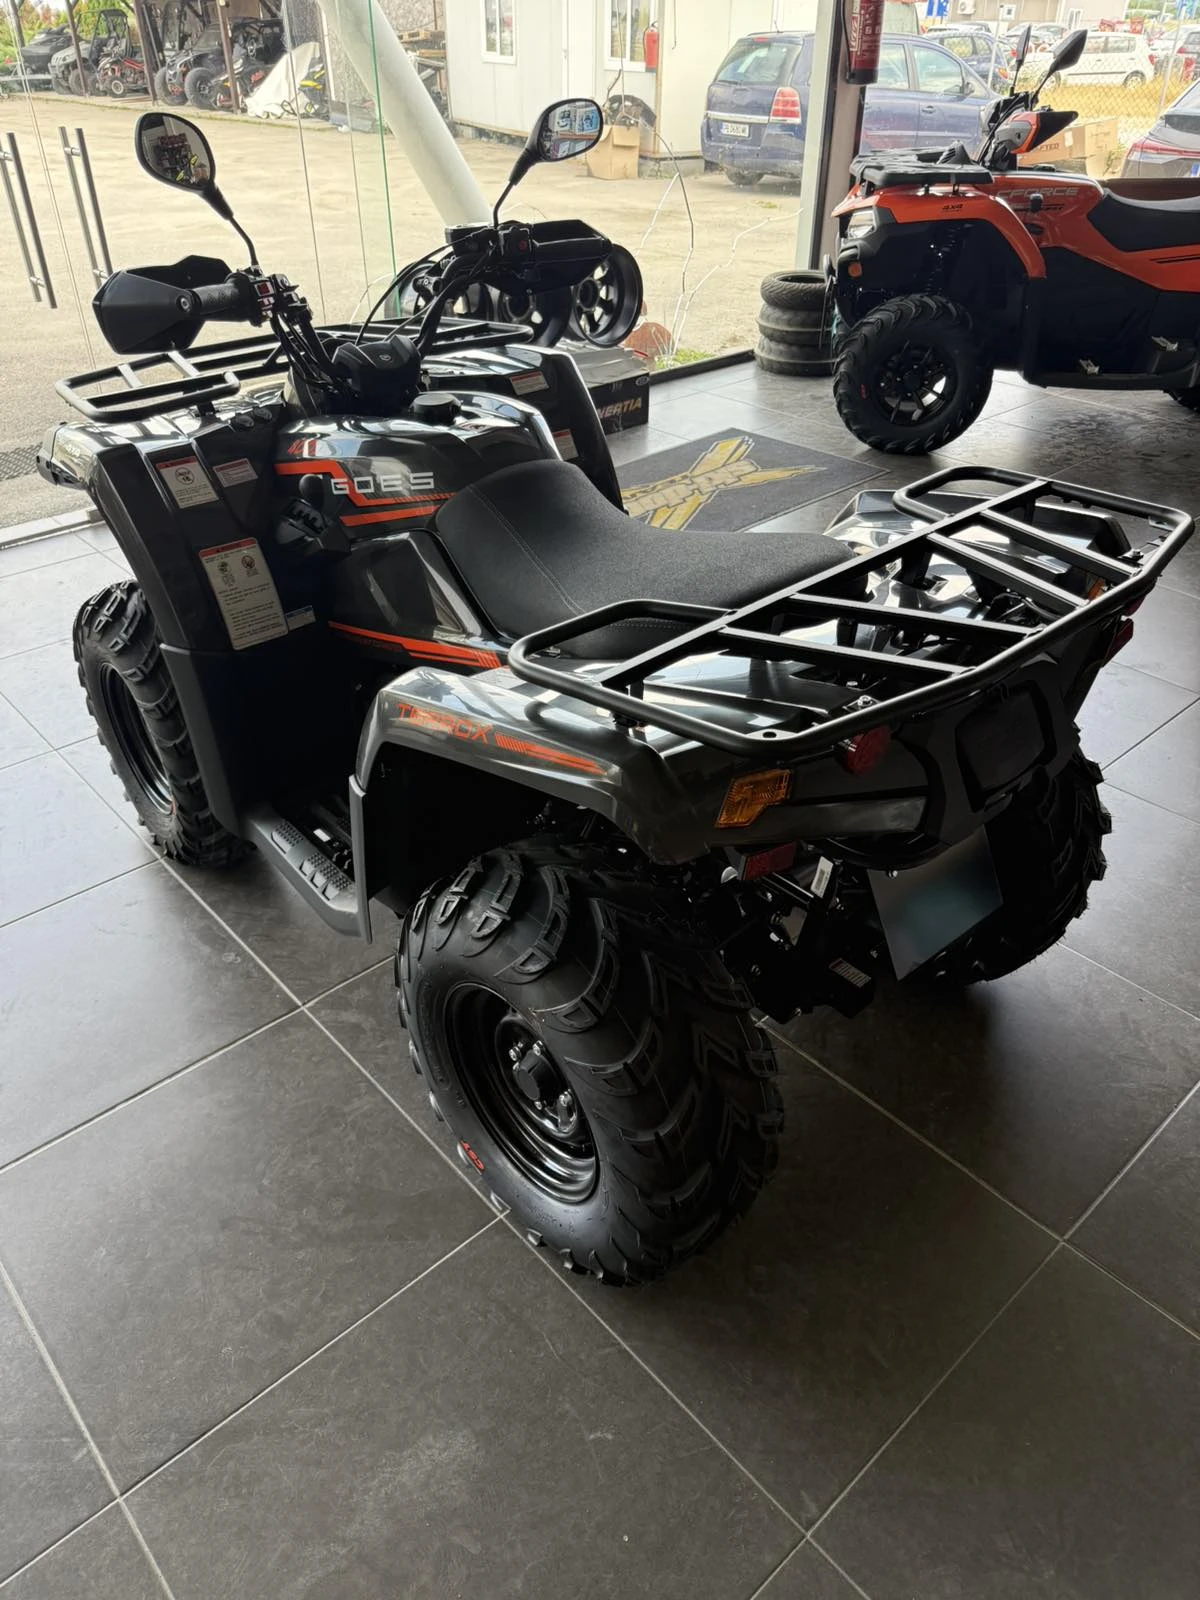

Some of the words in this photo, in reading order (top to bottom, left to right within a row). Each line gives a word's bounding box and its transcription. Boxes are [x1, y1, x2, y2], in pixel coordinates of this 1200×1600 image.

[597, 397, 642, 419] NERTIA
[331, 471, 434, 495] GOES
[396, 702, 496, 745] TERROX
